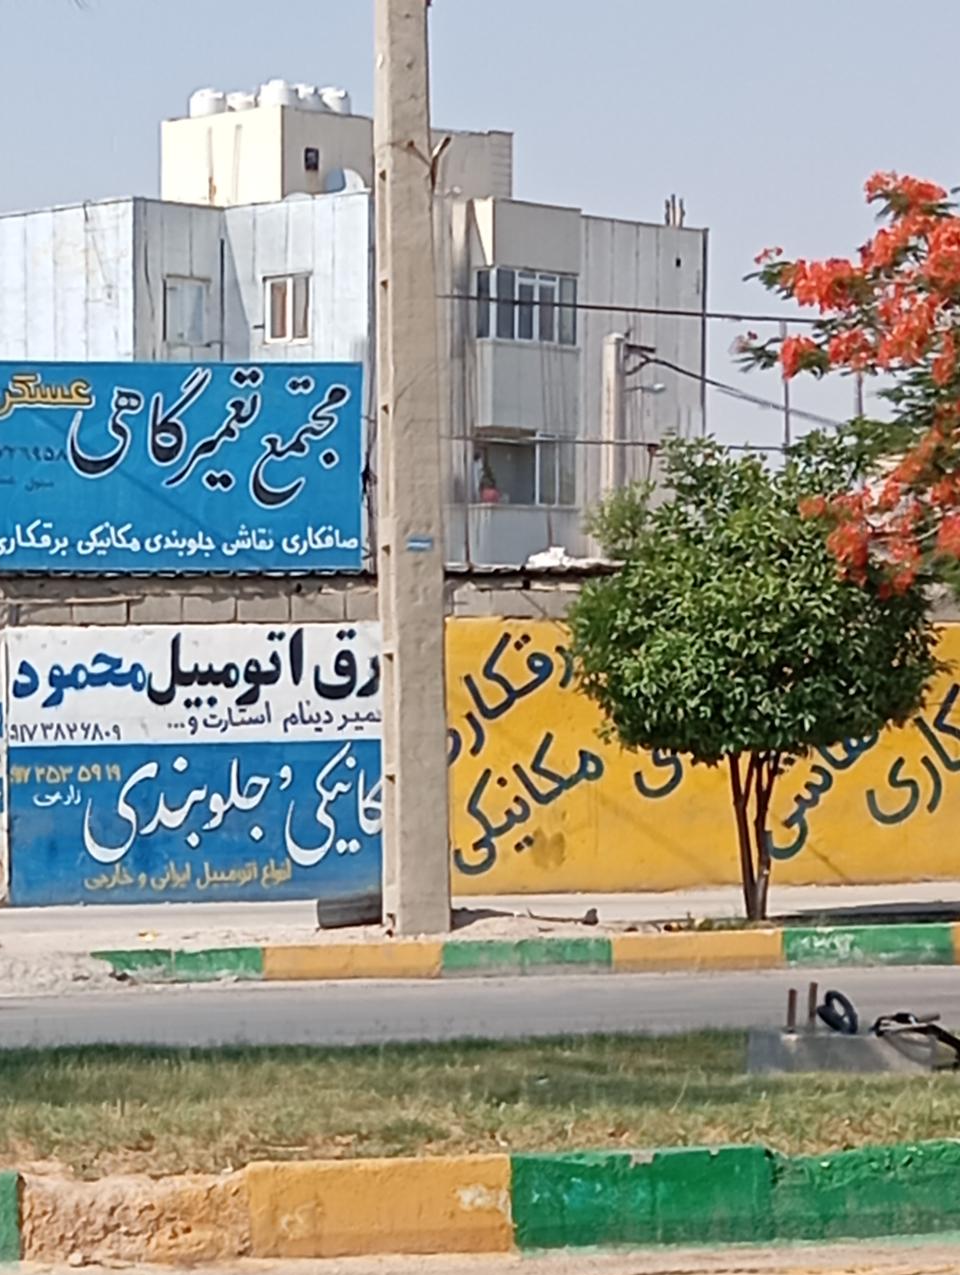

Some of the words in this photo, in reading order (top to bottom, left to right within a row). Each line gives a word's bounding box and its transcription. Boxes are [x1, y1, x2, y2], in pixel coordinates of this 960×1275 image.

[248, 376, 350, 509] مجتمع
[77, 522, 141, 557] مکانیکی
[144, 530, 216, 558] جلوبندی
[221, 525, 275, 557] نقاشی
[281, 524, 359, 556] صافکاری
[12, 650, 148, 708] محمود
[147, 626, 305, 708] اتومبیل
[313, 628, 381, 701] رق
[202, 700, 272, 733] استارت
[283, 699, 334, 733] دینام
[337, 708, 382, 732] میر
[82, 755, 271, 864] جلوبندی
[284, 740, 382, 867] کانیکی
[453, 732, 605, 876] مکانیکی
